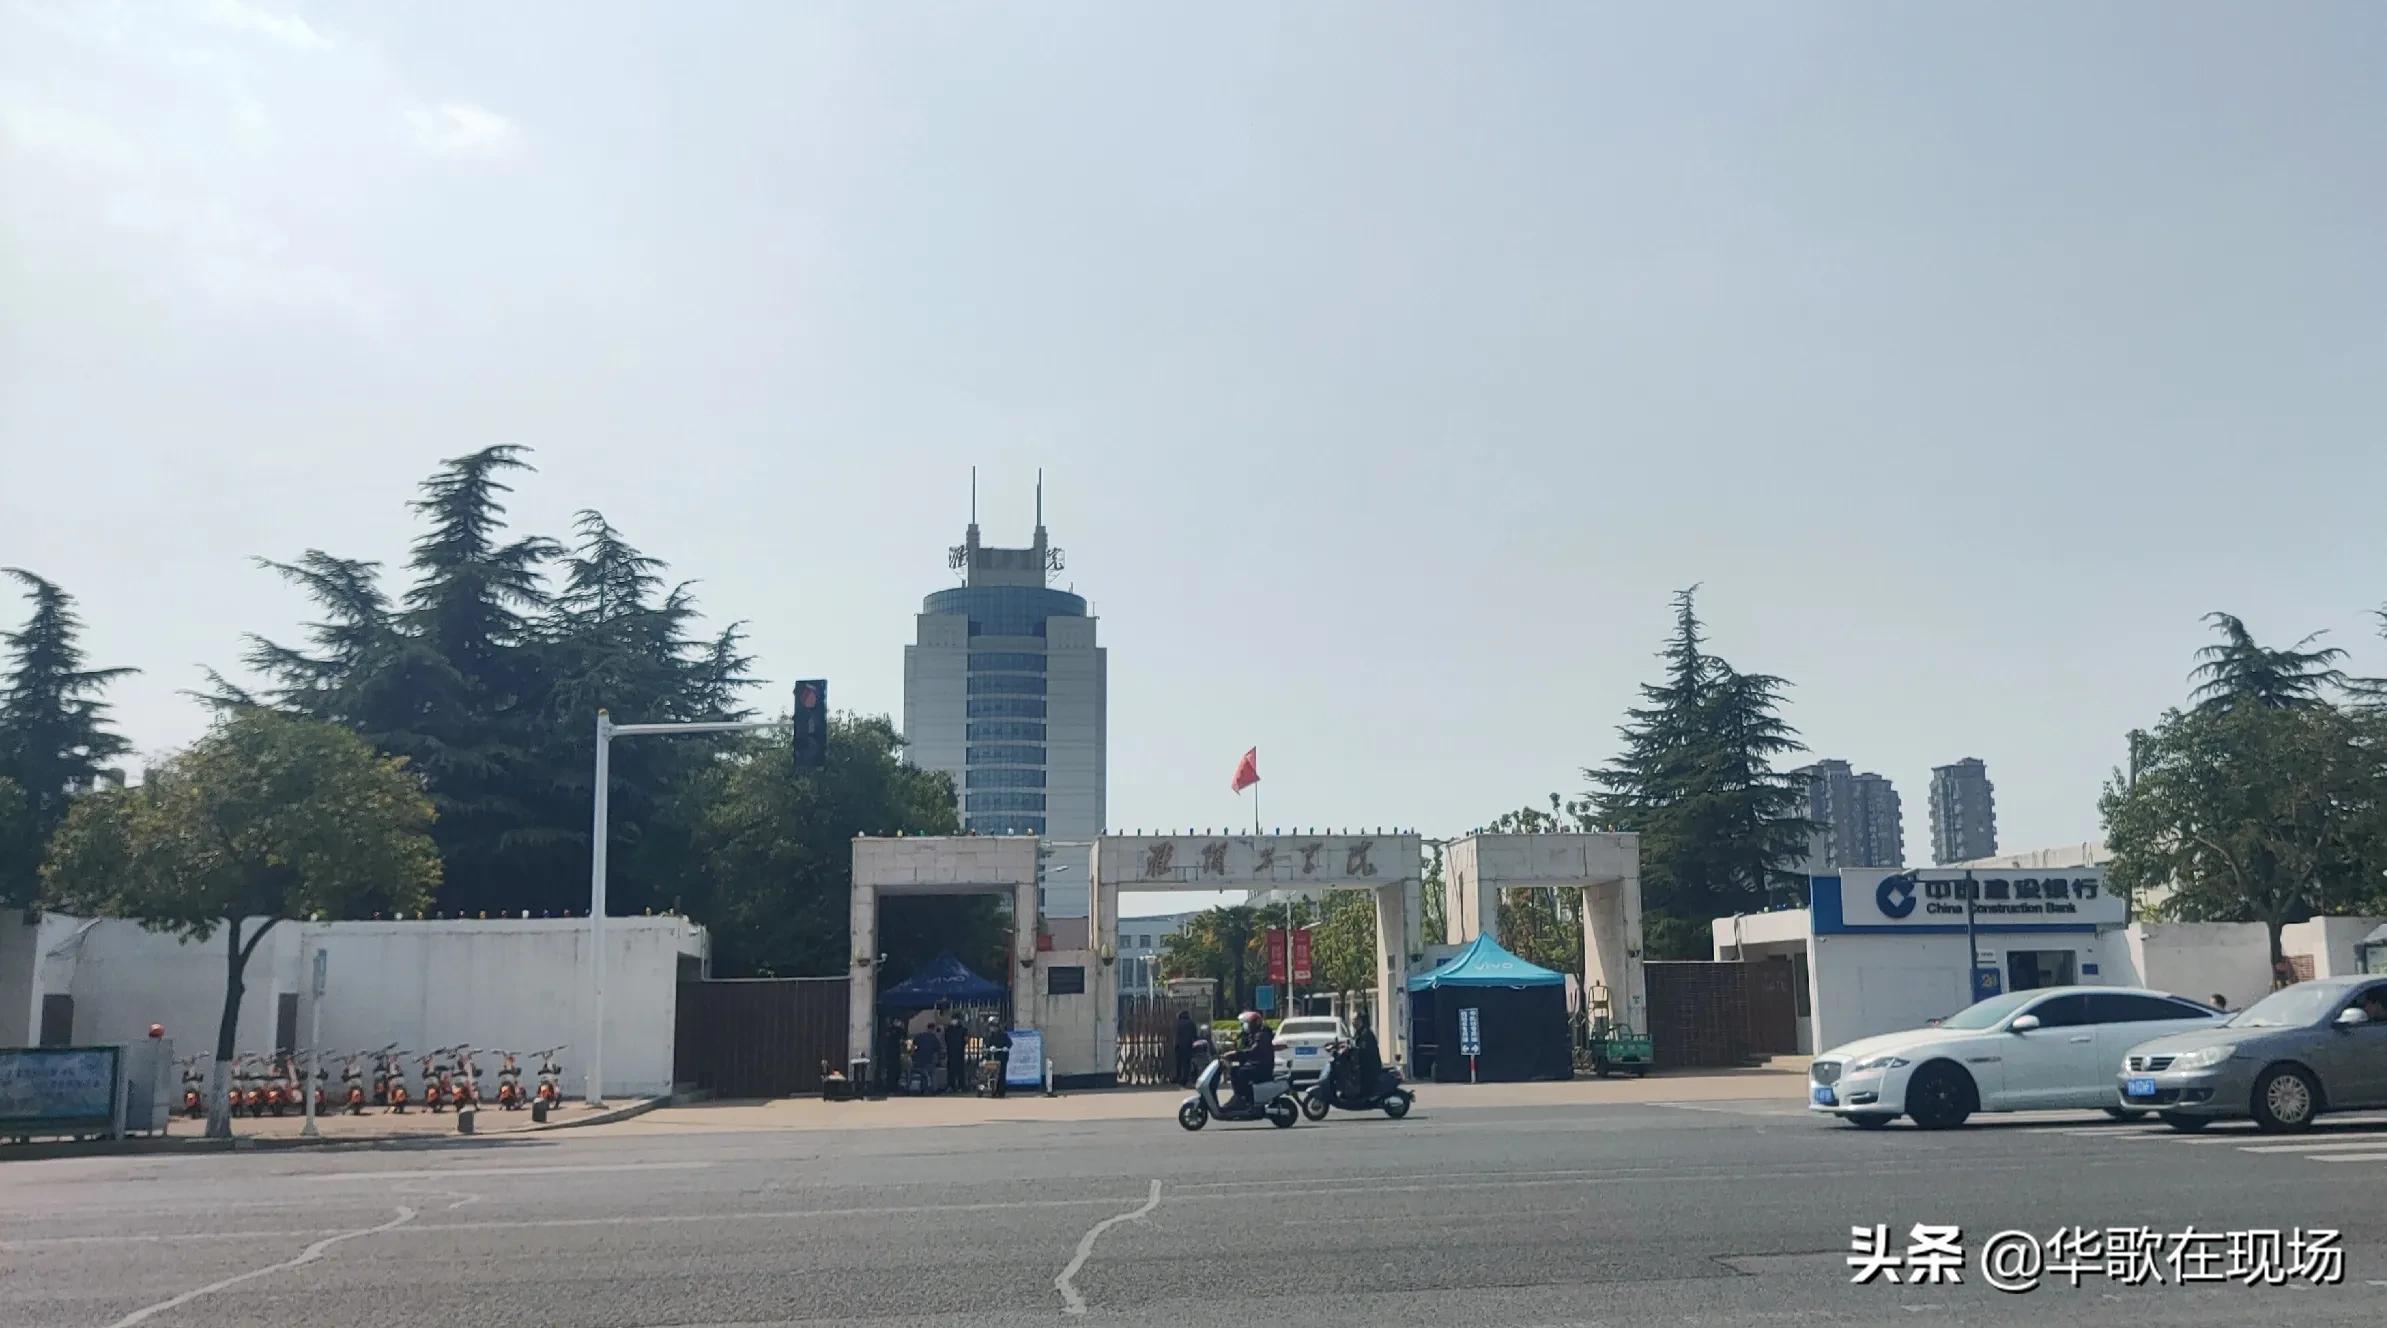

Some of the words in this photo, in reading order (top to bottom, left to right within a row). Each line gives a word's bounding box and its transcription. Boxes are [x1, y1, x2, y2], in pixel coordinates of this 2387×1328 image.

[1925, 878, 2098, 900] 中国建设银行
[1926, 902, 1963, 914] China
[2046, 902, 2077, 914] Bank
